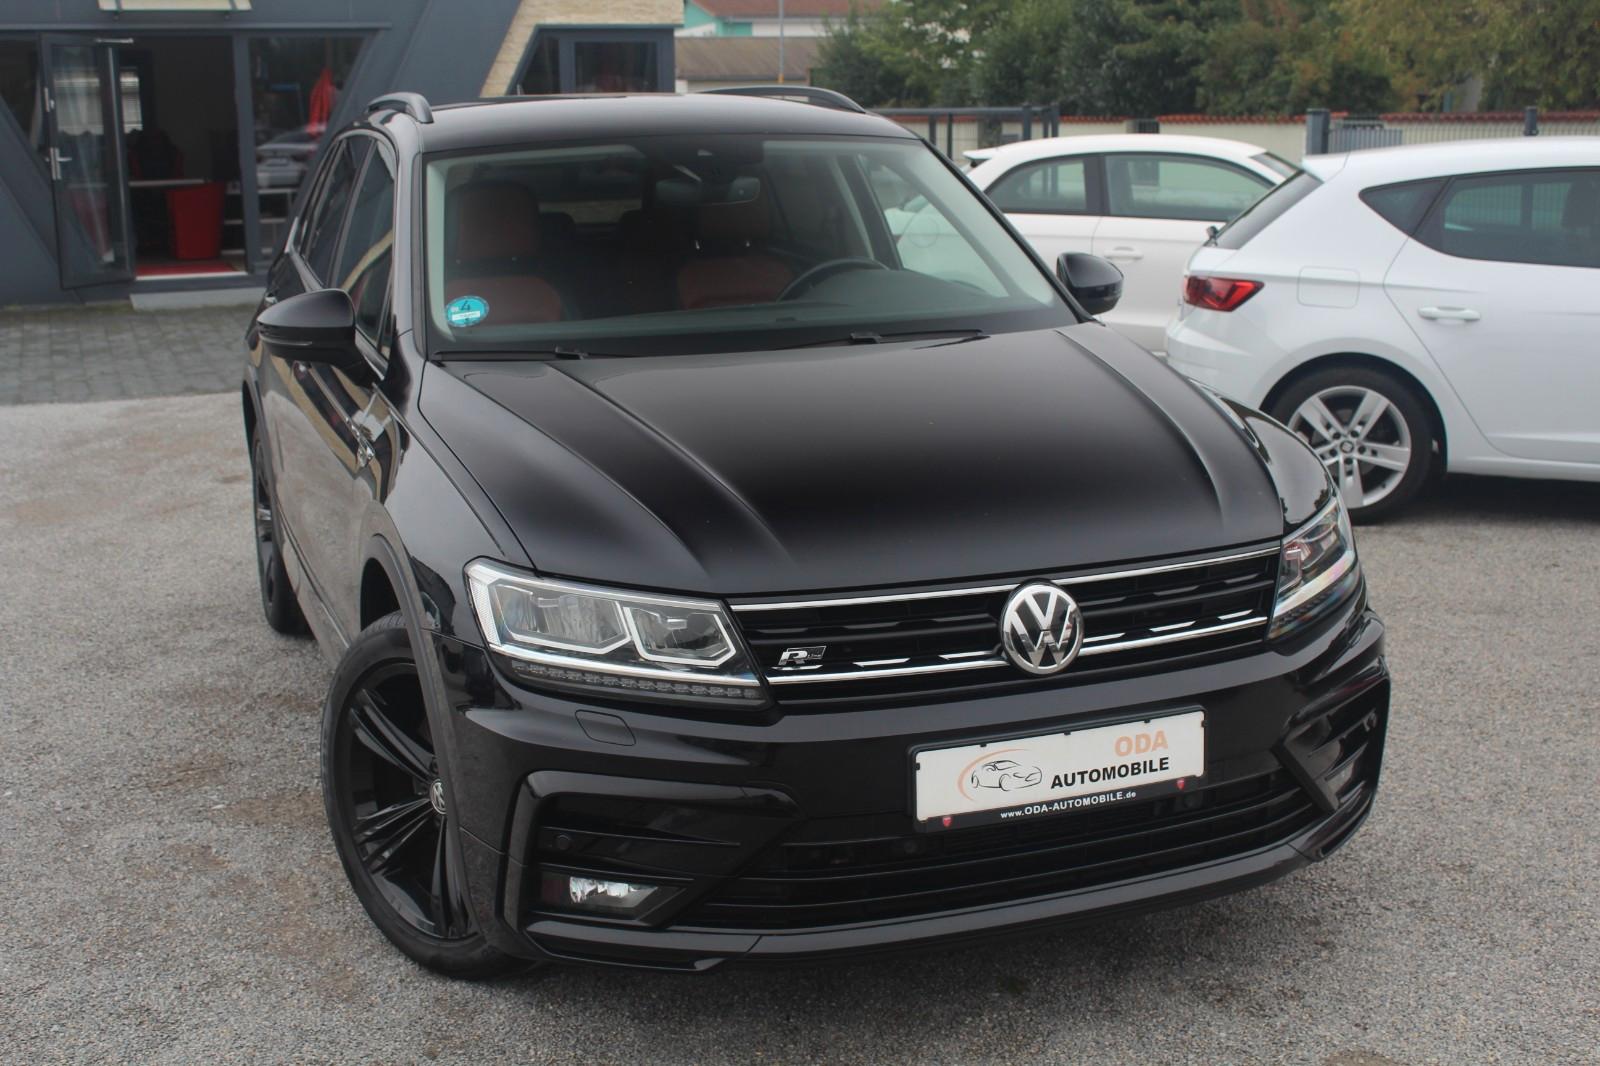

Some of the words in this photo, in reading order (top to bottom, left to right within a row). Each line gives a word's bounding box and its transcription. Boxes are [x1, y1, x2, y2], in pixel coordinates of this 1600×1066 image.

[1005, 586, 1079, 673] VW
[1113, 730, 1169, 757] ODA
[1050, 757, 1170, 789] AUTOMOBILE
[1000, 791, 1137, 819] www.ODA-AUTOMOBILE.de
